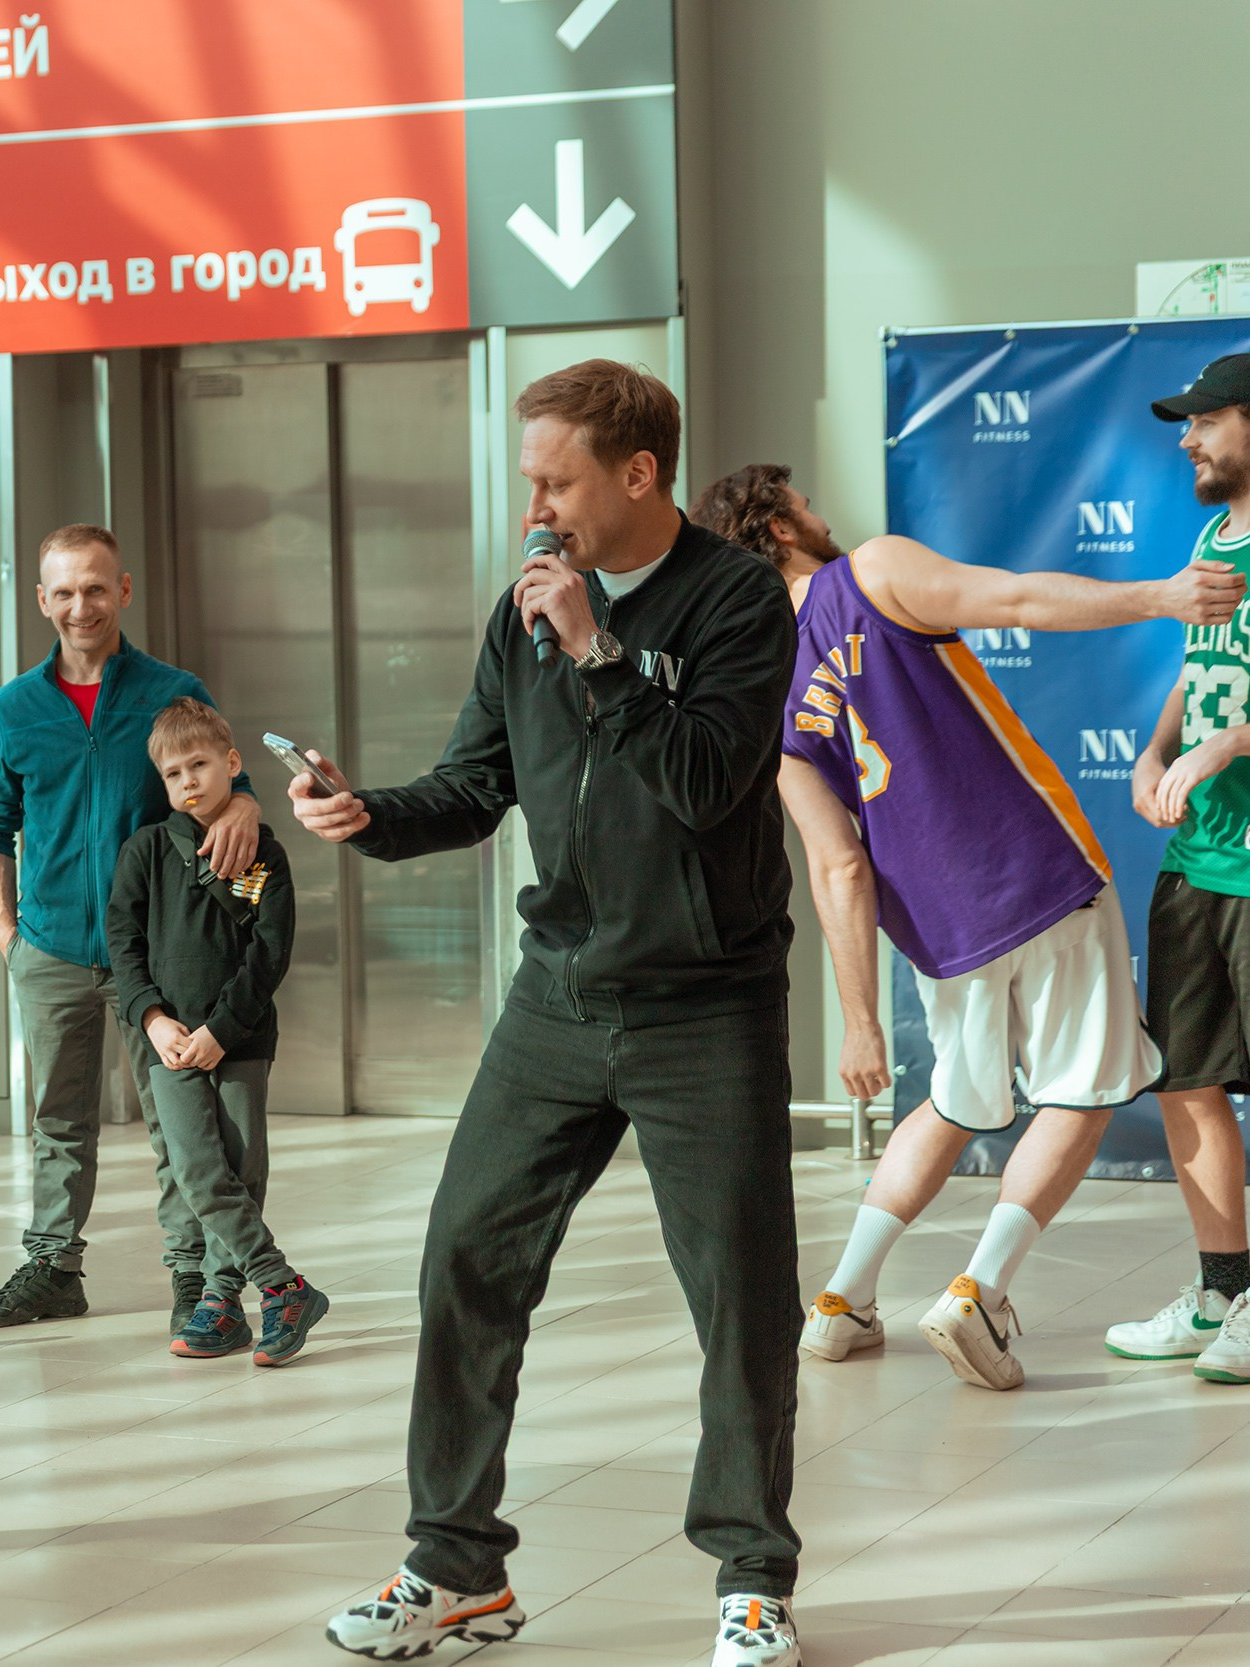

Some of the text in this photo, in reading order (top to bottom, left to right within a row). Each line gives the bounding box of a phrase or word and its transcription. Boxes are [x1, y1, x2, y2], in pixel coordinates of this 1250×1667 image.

[126, 257, 156, 295] в
[170, 246, 327, 301] город
[974, 390, 1031, 426] NN
[973, 430, 1031, 443] FITNESS
[1076, 500, 1135, 536] NN
[1076, 540, 1135, 553] FITNESS
[1078, 729, 1137, 762] NN
